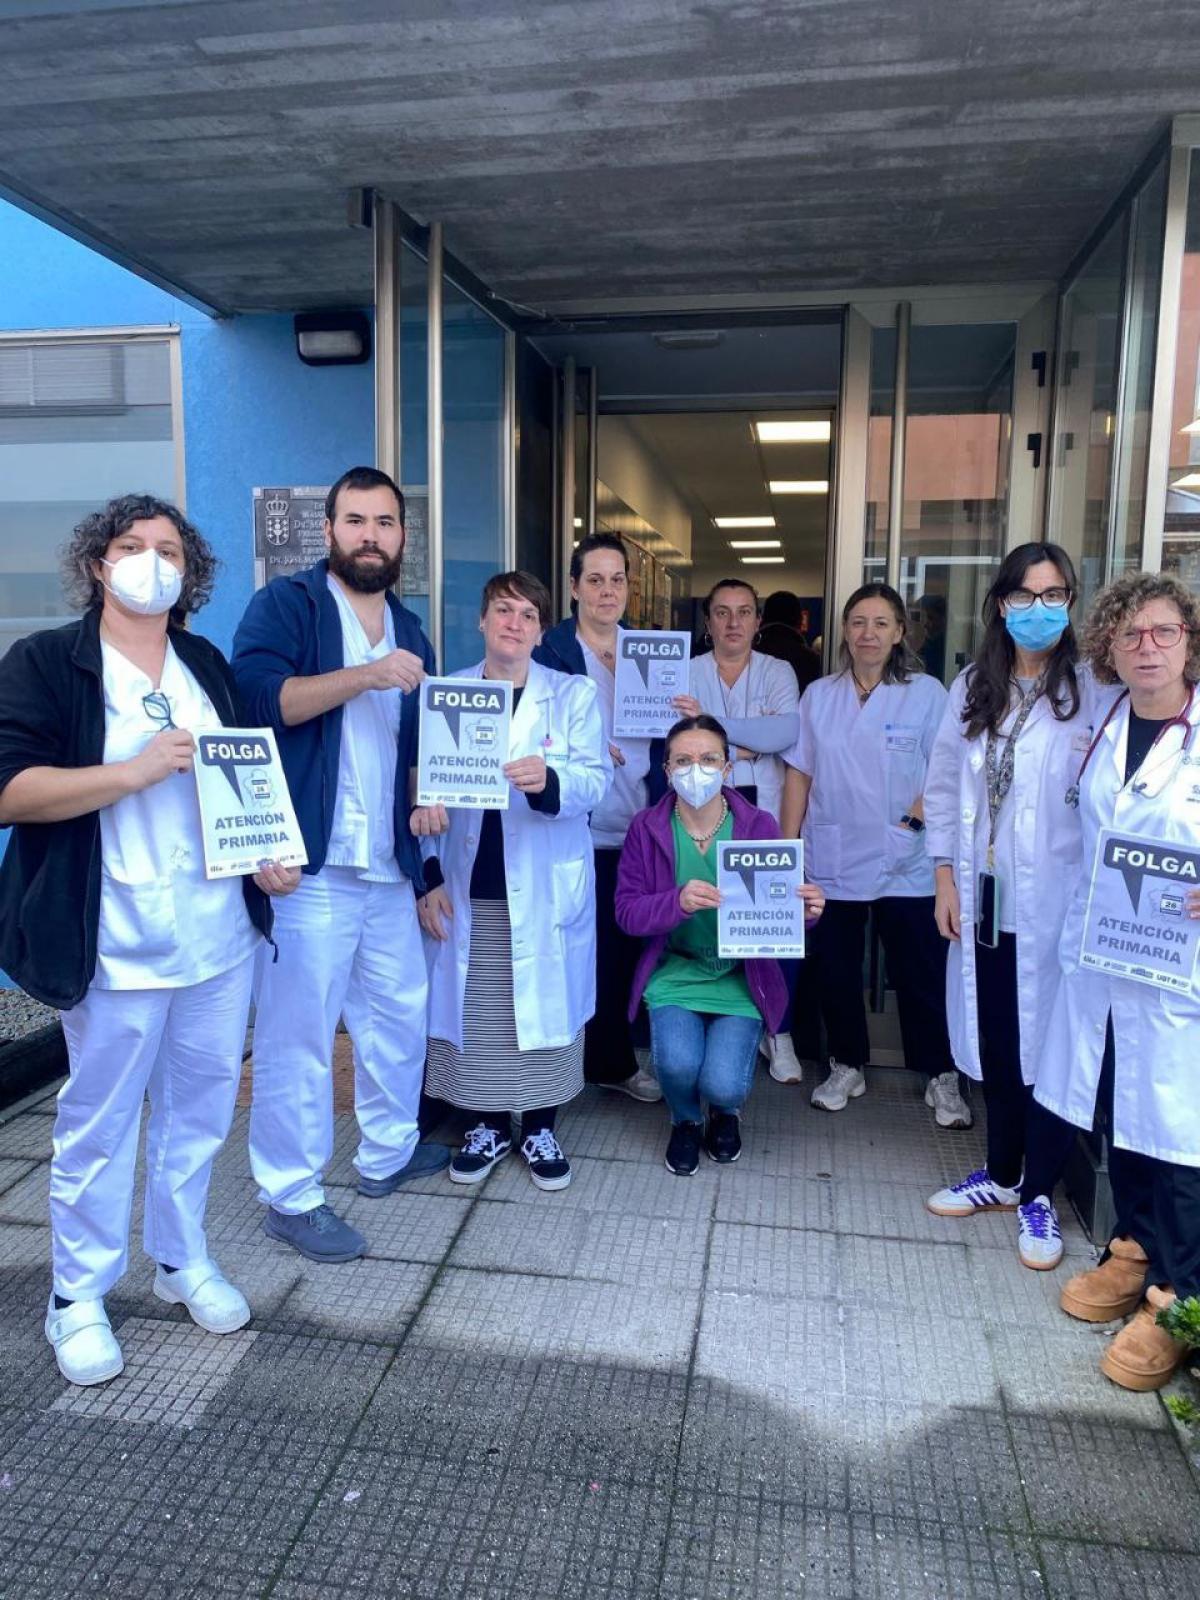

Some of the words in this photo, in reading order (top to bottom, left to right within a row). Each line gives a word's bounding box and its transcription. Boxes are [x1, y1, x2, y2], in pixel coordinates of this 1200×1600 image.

[627, 643, 681, 656] FOLGA
[433, 691, 501, 709] FOLGA
[624, 709, 679, 719] PRIMARIA
[206, 743, 267, 760] FOLGA
[428, 755, 500, 769] ATENCIÓN
[430, 772, 498, 785] PRIMARIA
[214, 811, 286, 830] ATENCIÓN
[218, 831, 289, 850] PRIMARIA
[729, 853, 792, 867] FOLGA
[1112, 847, 1197, 878] FOLGA
[1164, 901, 1177, 909] 26
[728, 908, 795, 921] ATENCIÓN
[729, 926, 794, 937] PRIMARIA
[1097, 916, 1189, 945] ATENCIÓN
[1097, 934, 1182, 965] PRIMARIA
